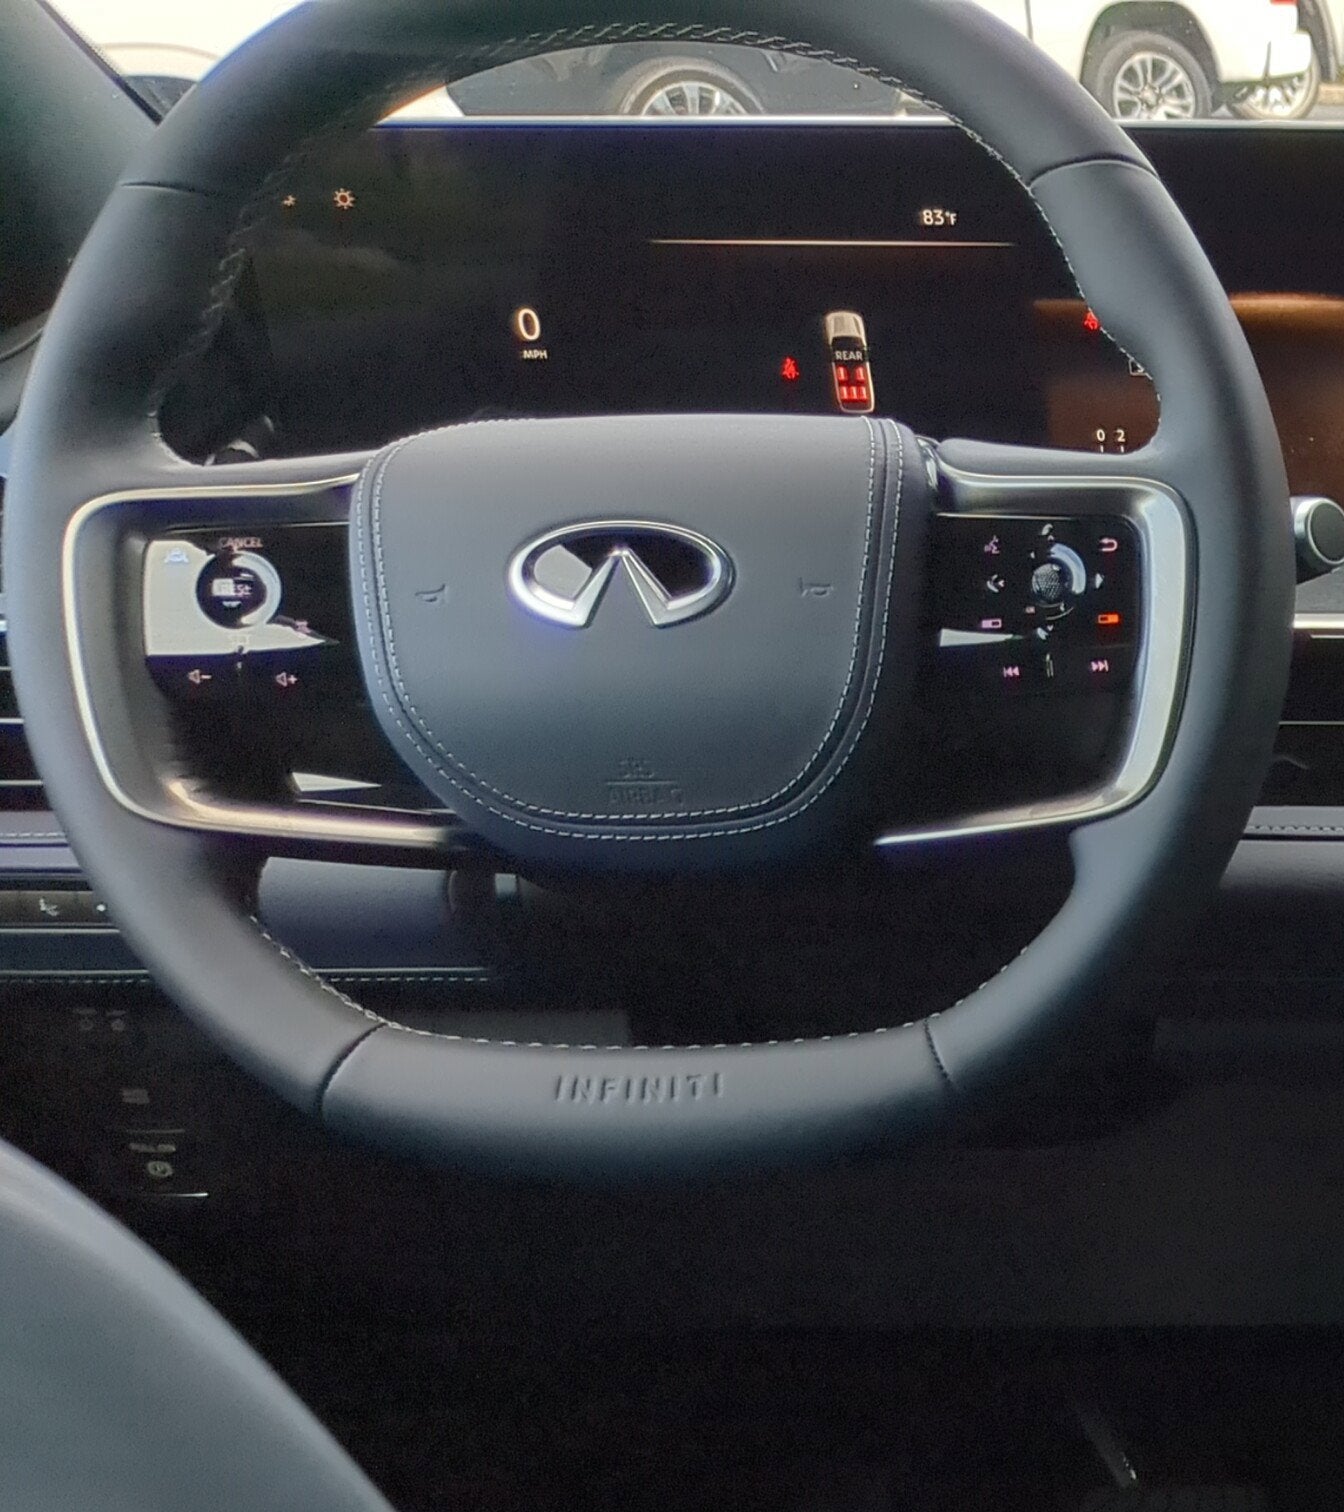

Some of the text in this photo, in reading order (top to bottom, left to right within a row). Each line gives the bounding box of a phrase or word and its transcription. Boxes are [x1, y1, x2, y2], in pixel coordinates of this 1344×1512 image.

[518, 308, 541, 341] 0
[523, 349, 548, 360] MPH
[835, 351, 863, 361] REAR
[1116, 429, 1126, 442] 2
[219, 536, 264, 548] CANCEL
[556, 1071, 726, 1106] INFINITI
